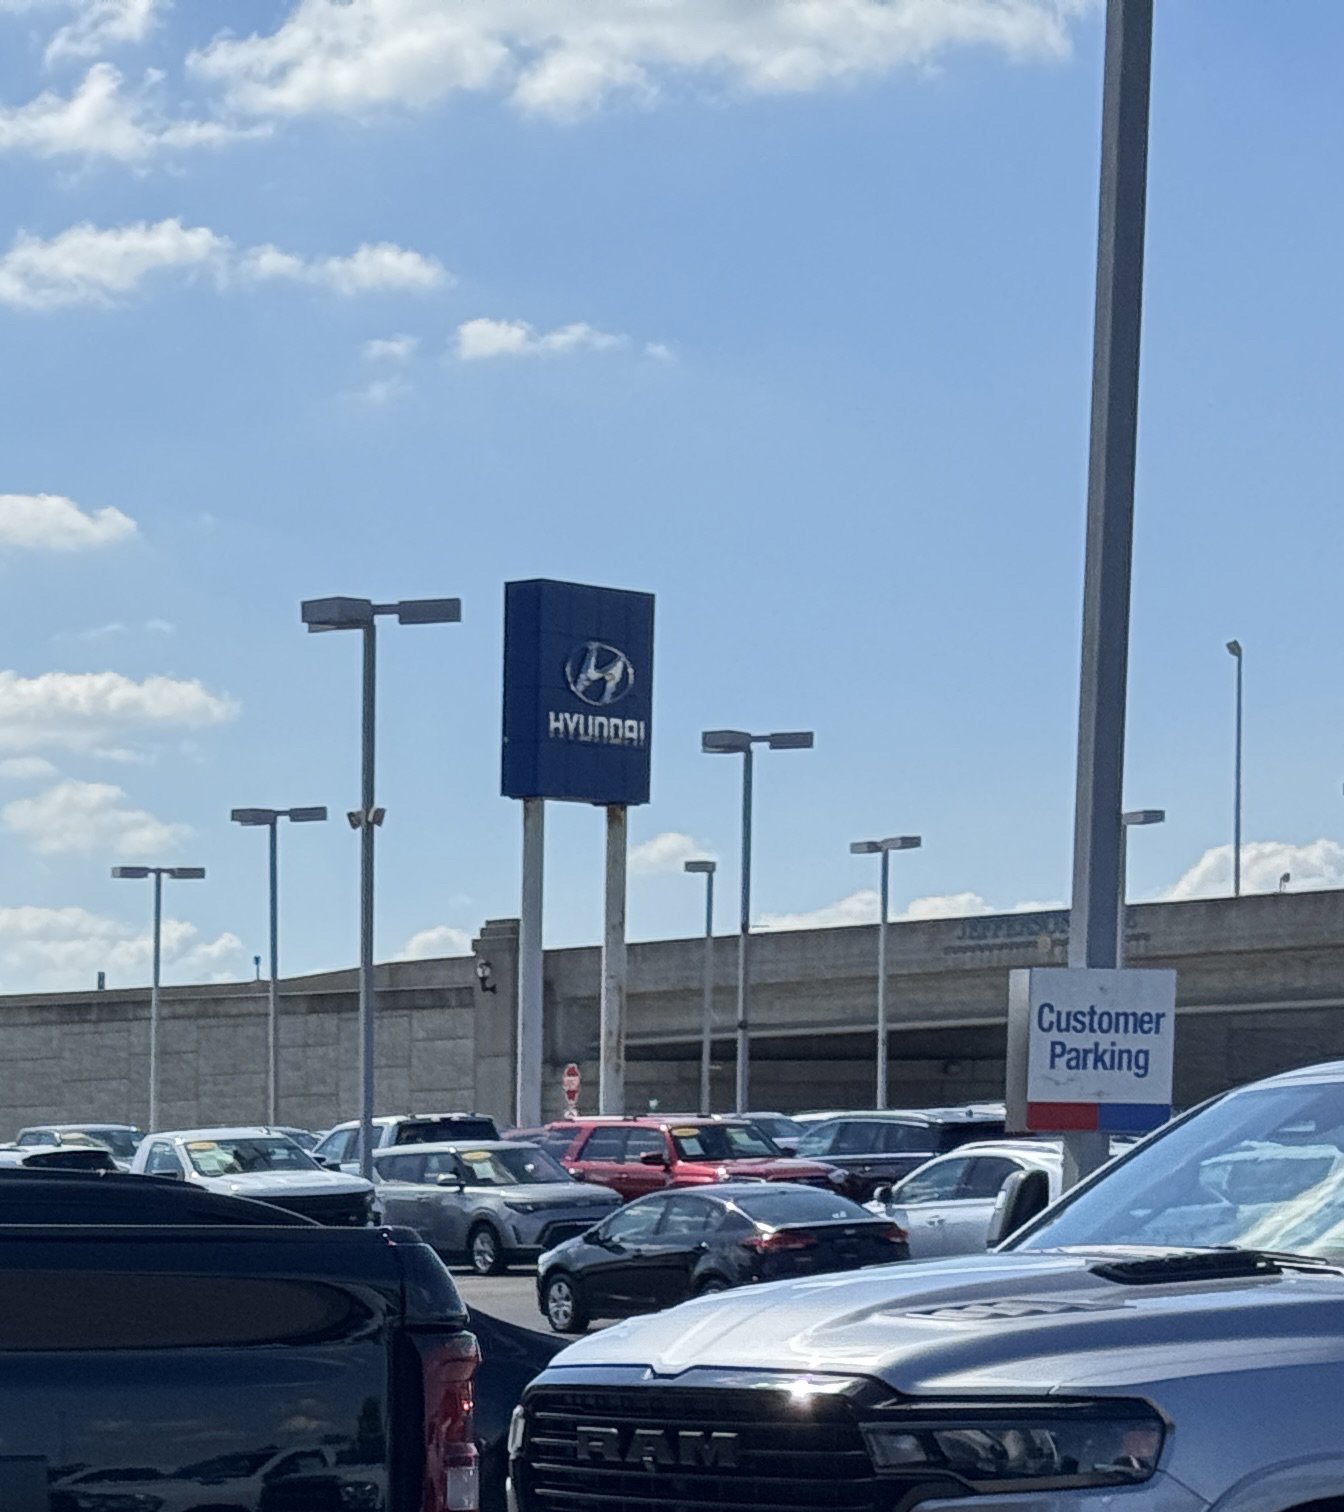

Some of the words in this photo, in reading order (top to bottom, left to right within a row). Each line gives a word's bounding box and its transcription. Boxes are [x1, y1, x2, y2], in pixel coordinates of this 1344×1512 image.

[549, 711, 645, 746] HYUNDAI
[1037, 1002, 1166, 1035] Customer
[1049, 1041, 1150, 1079] Parking
[576, 1425, 739, 1467] RAM
